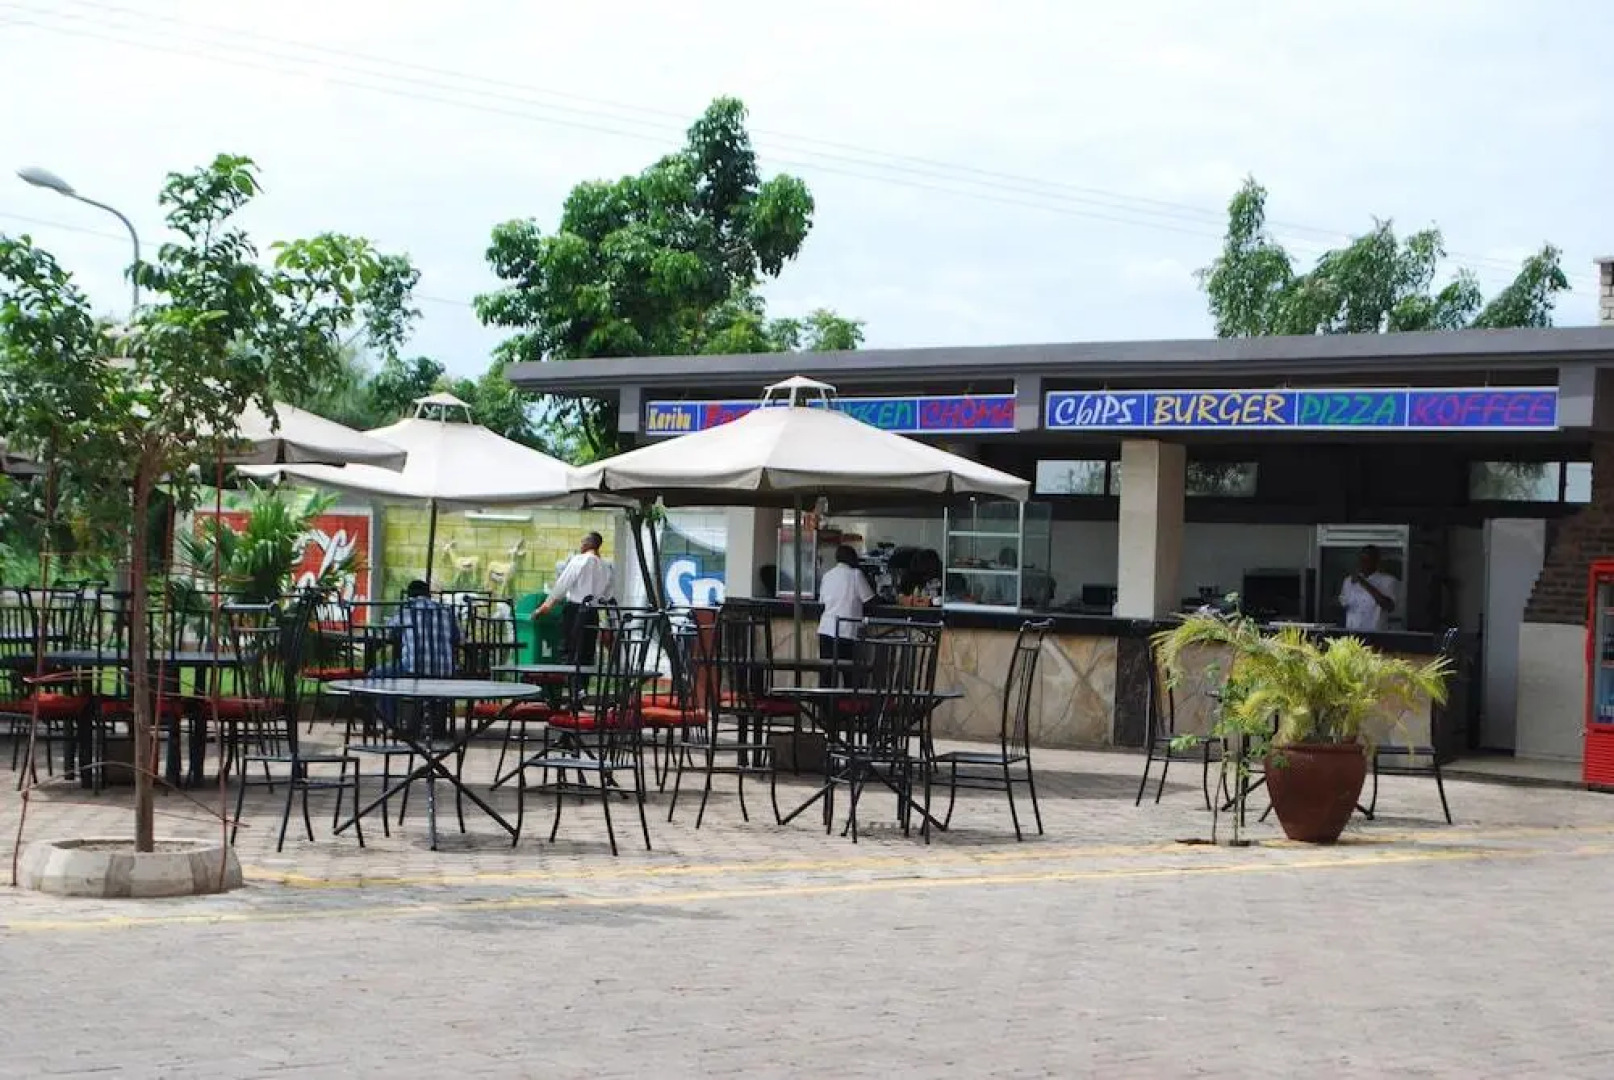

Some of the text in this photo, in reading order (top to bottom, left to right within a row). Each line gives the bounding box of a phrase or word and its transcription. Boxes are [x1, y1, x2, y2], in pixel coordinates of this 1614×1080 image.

[648, 406, 692, 431] Karibu
[1153, 394, 1286, 425] BURGER
[1300, 395, 1396, 424] PIZZA
[1411, 394, 1551, 424] KOFFEE
